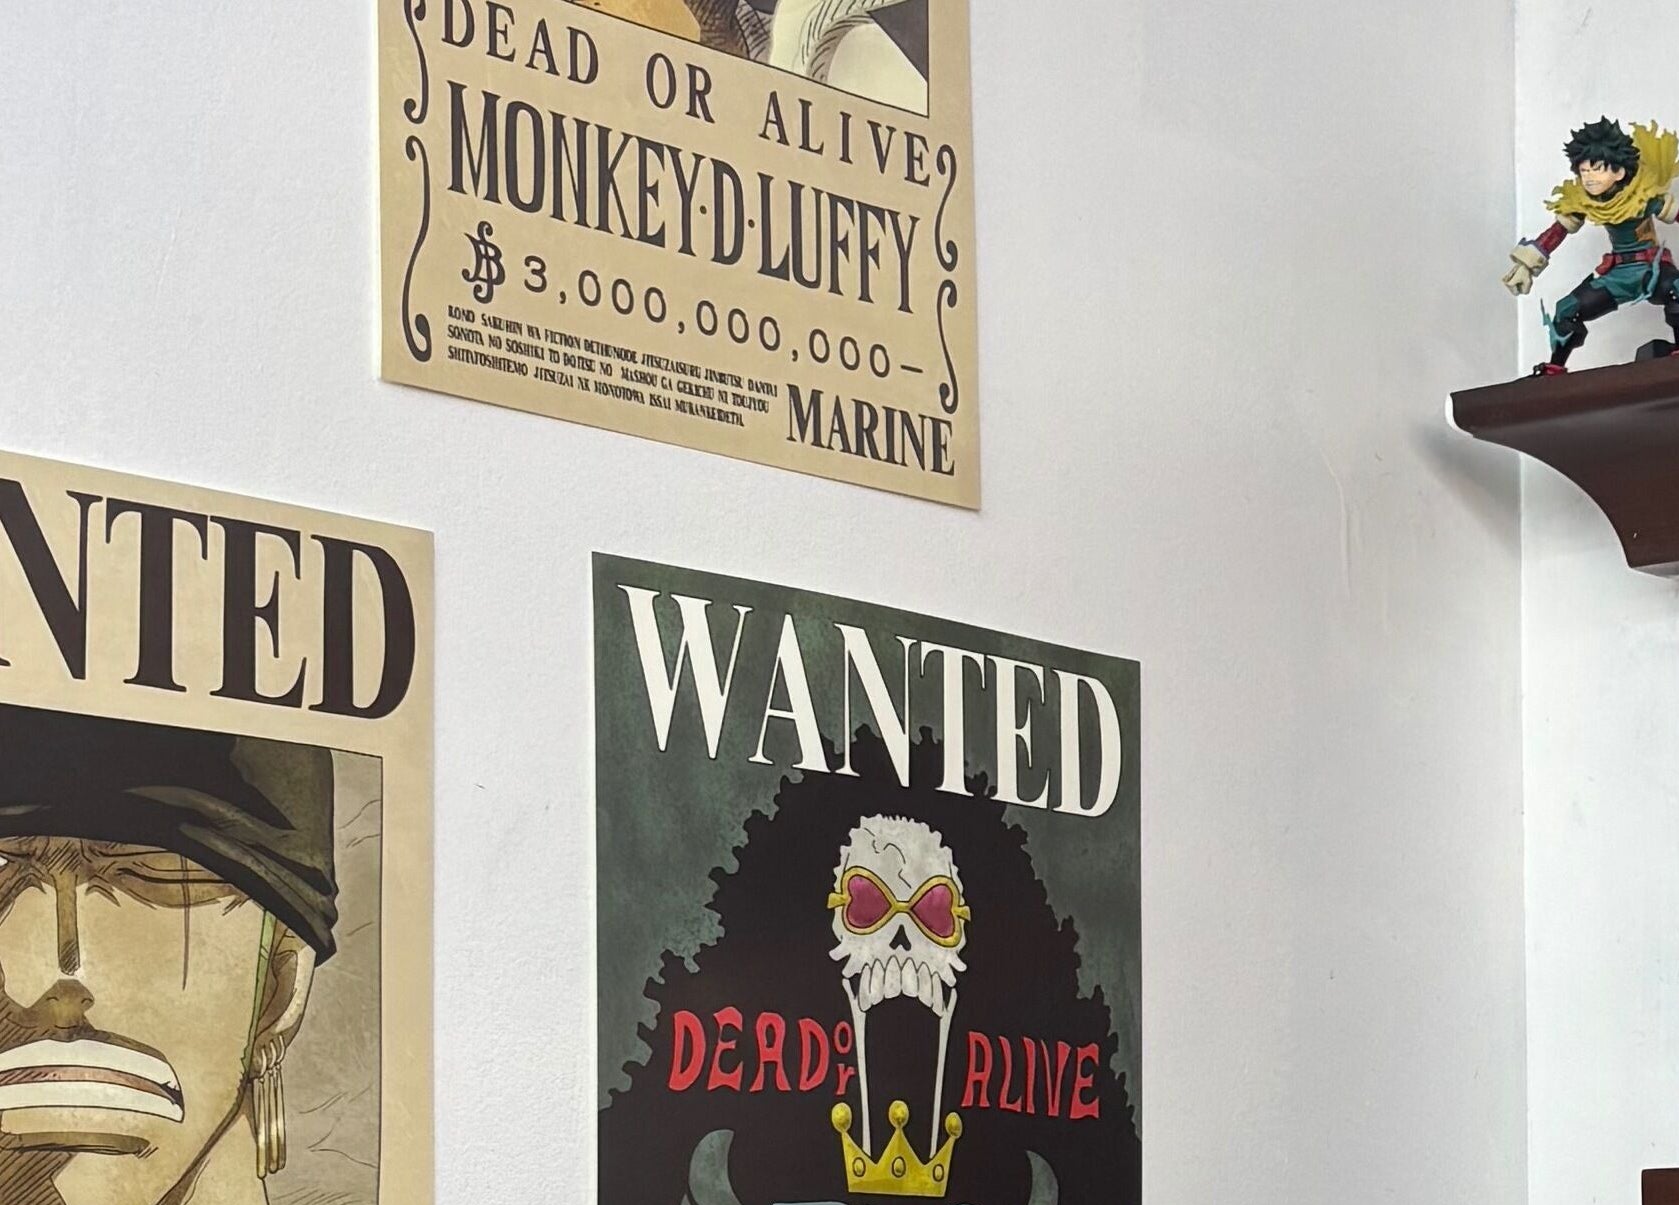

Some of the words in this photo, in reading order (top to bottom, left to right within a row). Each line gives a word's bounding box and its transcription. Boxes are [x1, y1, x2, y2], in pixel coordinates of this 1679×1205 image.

[441, 0, 599, 84] DEAD
[646, 52, 715, 124] OR
[758, 90, 932, 188] ALIVE
[545, 328, 581, 350] FICTION
[549, 348, 560, 364] TO
[600, 362, 613, 377] NO
[786, 384, 956, 477] MARINE
[617, 584, 1122, 818] WANTED
[667, 1006, 830, 1092] DEAD
[960, 1031, 1100, 1119] ALIVE
